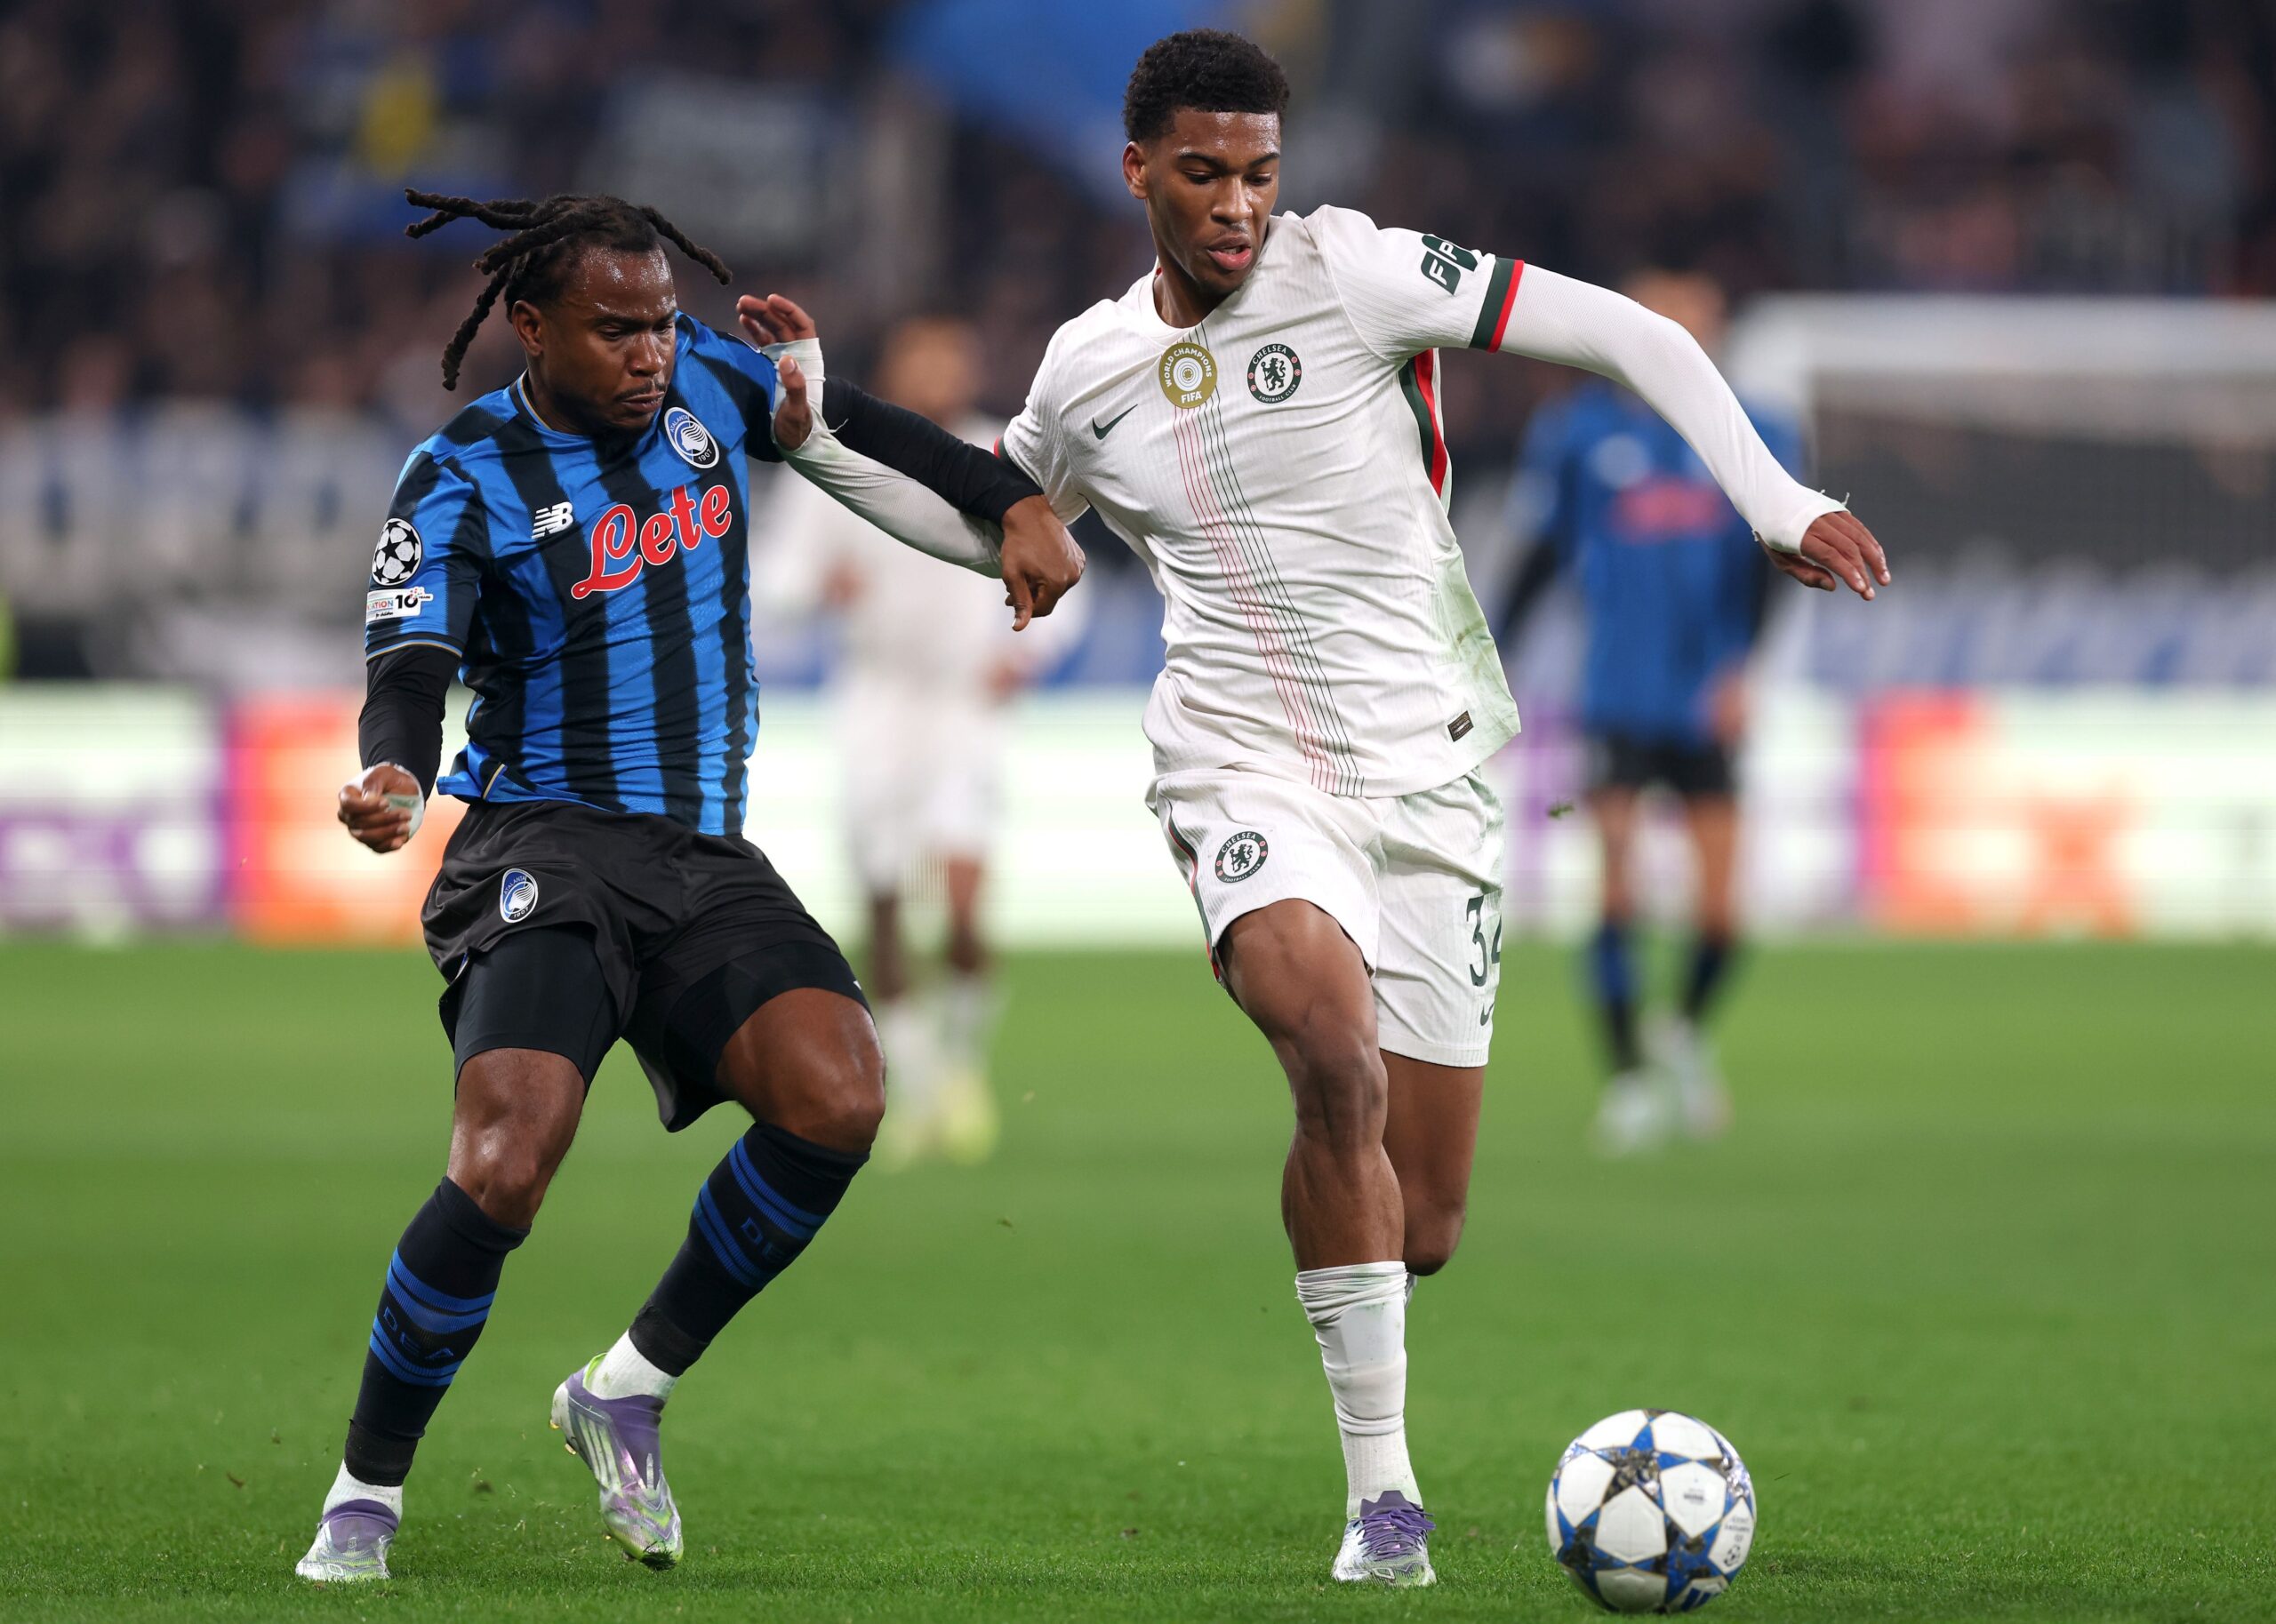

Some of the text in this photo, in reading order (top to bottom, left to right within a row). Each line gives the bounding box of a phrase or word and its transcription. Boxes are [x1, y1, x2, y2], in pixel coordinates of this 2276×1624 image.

[1252, 344, 1287, 365] CHELSEA
[1164, 347, 1213, 388] WORLD CHAMPIONS
[1181, 390, 1203, 404] FIFA
[1259, 383, 1297, 403] FOOTBALL CLUB
[669, 414, 689, 433] ATALANTA
[698, 448, 713, 462] 1907
[571, 484, 732, 599] Lete
[367, 600, 393, 611] ATION
[396, 595, 418, 609] 10
[1221, 832, 1256, 853] CHELSEA
[503, 875, 526, 895] ATALANTA
[513, 906, 530, 918] 1907
